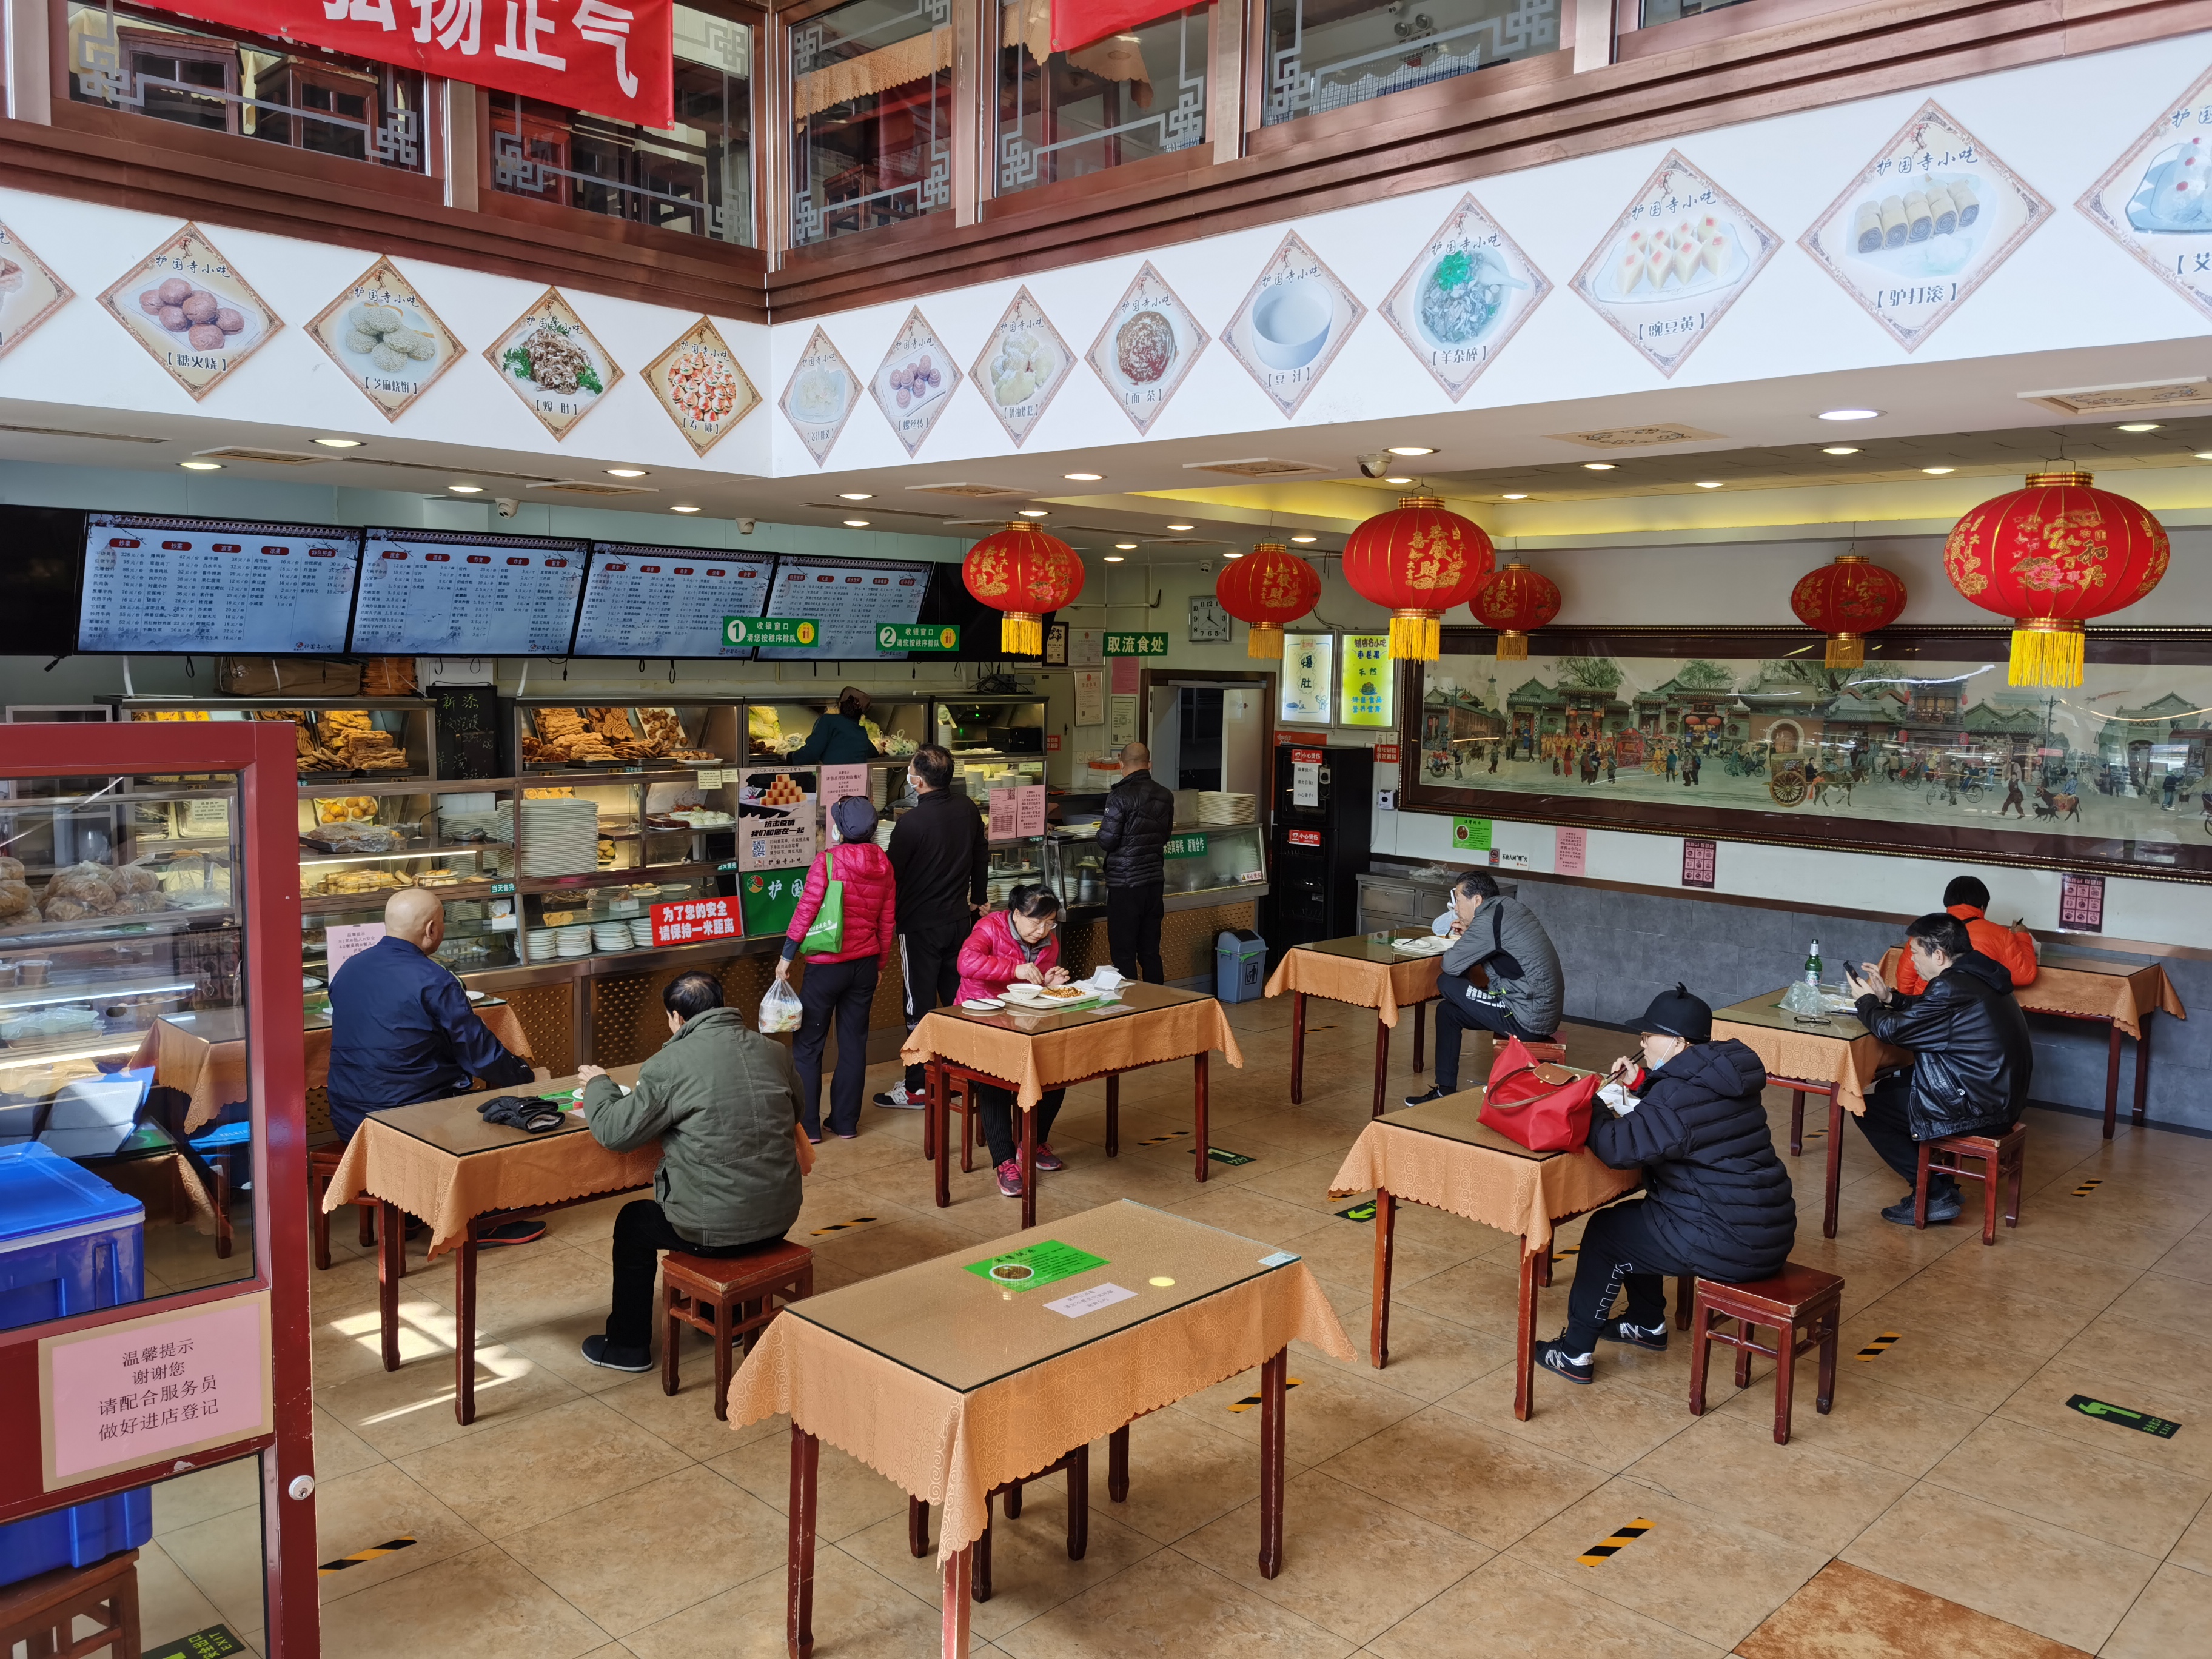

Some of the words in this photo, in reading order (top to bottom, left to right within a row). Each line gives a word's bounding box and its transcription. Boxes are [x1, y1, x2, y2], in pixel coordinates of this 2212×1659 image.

[1877, 146, 1978, 176] 护国寺小吃
[1631, 189, 1717, 221] 护国寺小吃
[1431, 233, 1501, 256] 护国寺小吃
[155, 255, 230, 278] 护国寺小吃
[1262, 264, 1321, 289] 护国寺小吃
[354, 287, 420, 307] 护国寺小吃
[1122, 293, 1172, 313] 护国寺小吃
[526, 316, 583, 335] 护国寺小吃
[1000, 319, 1044, 333] 护国寺小吃
[680, 341, 729, 362] 护国寺小吃
[896, 335, 934, 350] 护国寺小吃
[802, 352, 836, 367] 护国寺小吃
[732, 623, 739, 639] 1
[757, 622, 789, 630] 收银窗口
[905, 628, 934, 636] 收银窗口
[746, 634, 796, 642] 请您按秩序排队
[884, 629, 893, 645] 2
[897, 638, 940, 648] 请您按秩序排队
[1107, 636, 1164, 653] 取流食处
[751, 827, 805, 837] 我们和您在一起
[663, 901, 727, 922] 为了您的安全
[659, 917, 734, 941] 请保持一米距离
[122, 1338, 194, 1367] 温馨提示
[132, 1361, 185, 1385] 谢谢您
[98, 1374, 217, 1416] 请配合服务员
[99, 1398, 219, 1442] 做好进店登记
